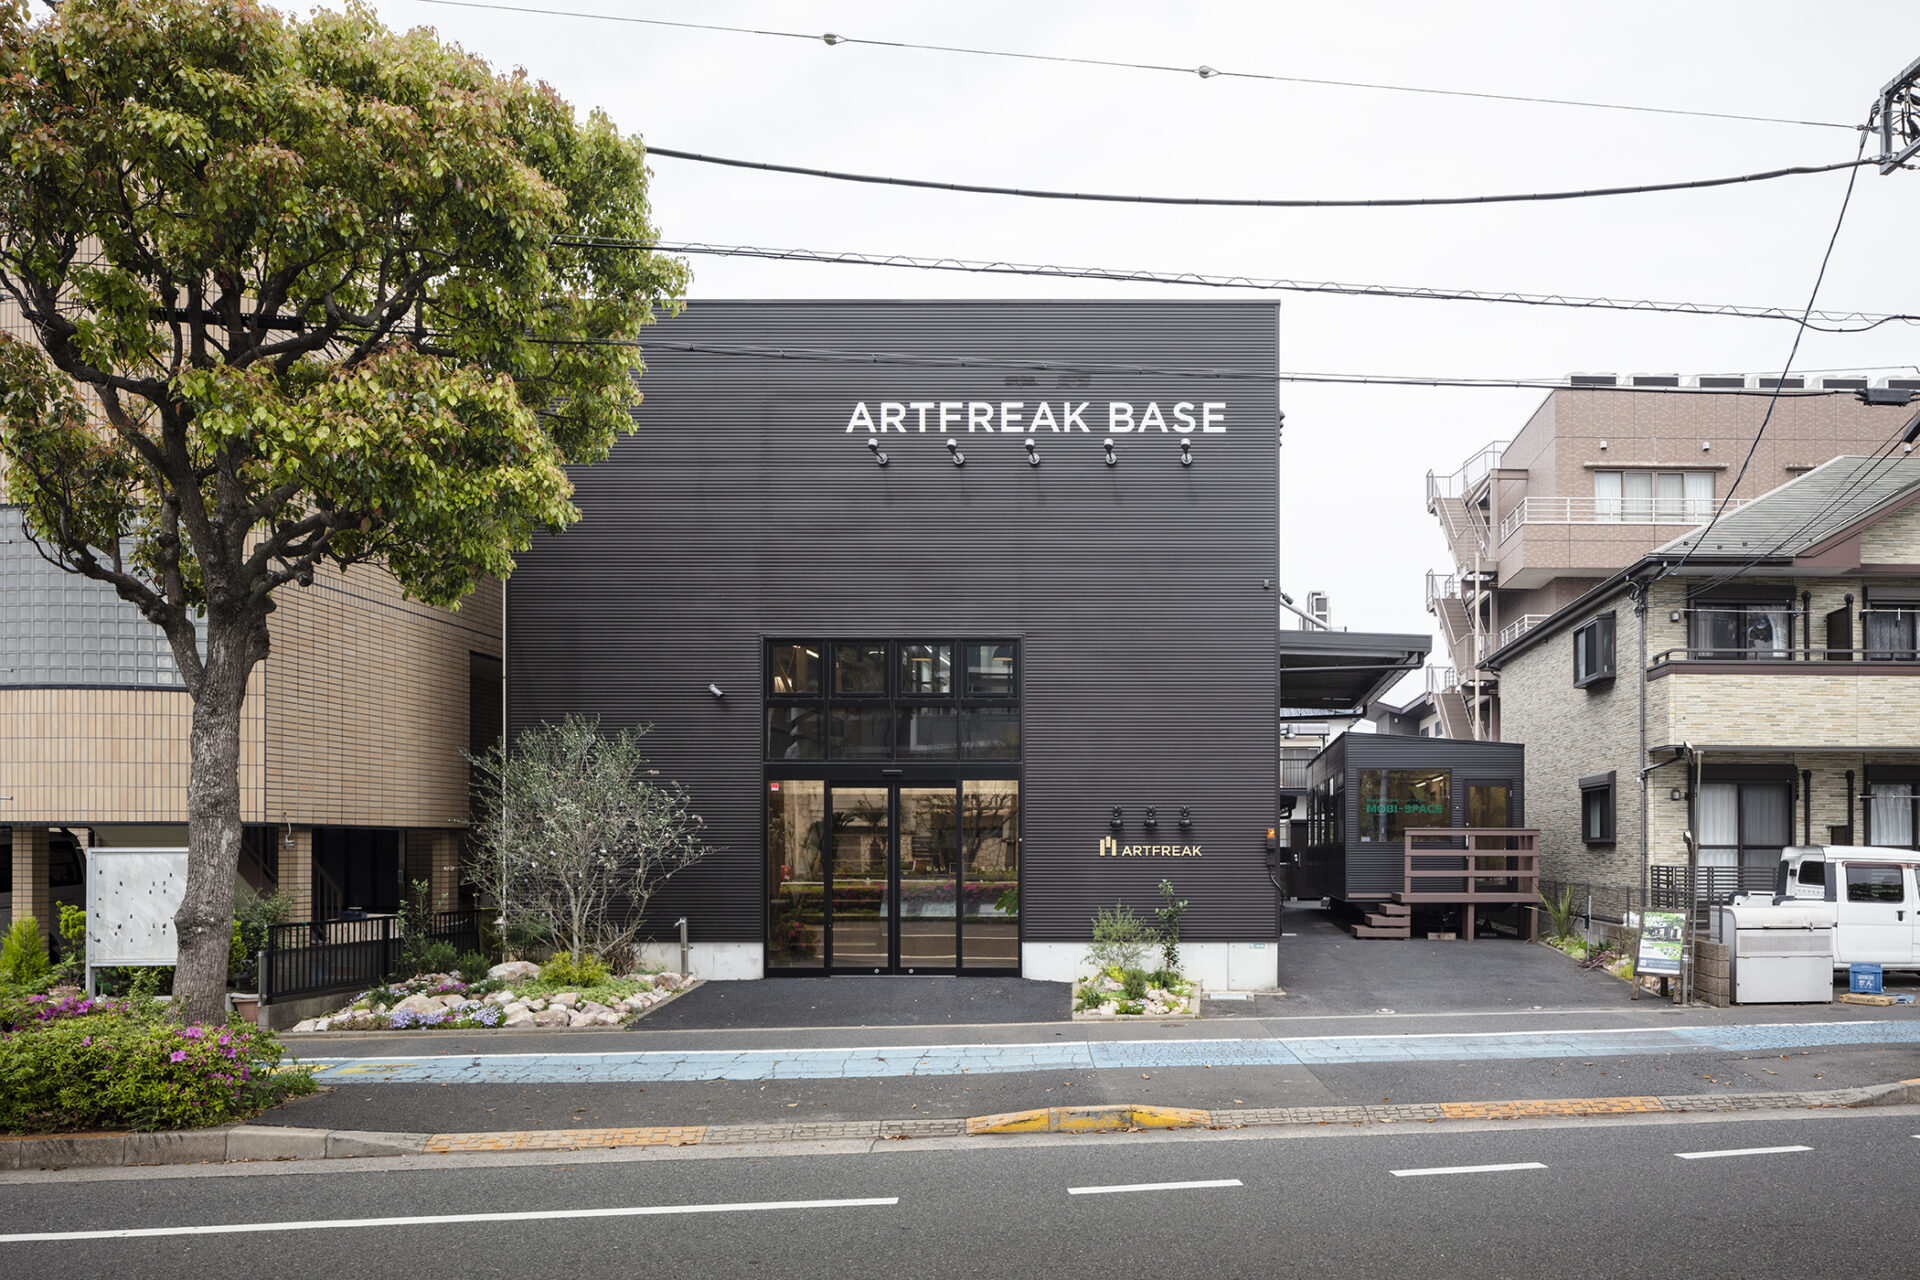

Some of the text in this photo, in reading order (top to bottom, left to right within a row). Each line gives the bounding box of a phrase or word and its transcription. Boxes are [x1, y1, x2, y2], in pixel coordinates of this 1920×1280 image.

[846, 401, 1227, 433] ARTFREAK BASE
[1366, 803, 1443, 814] MOBI-SPACE
[1121, 845, 1202, 857] ARTFREAK
